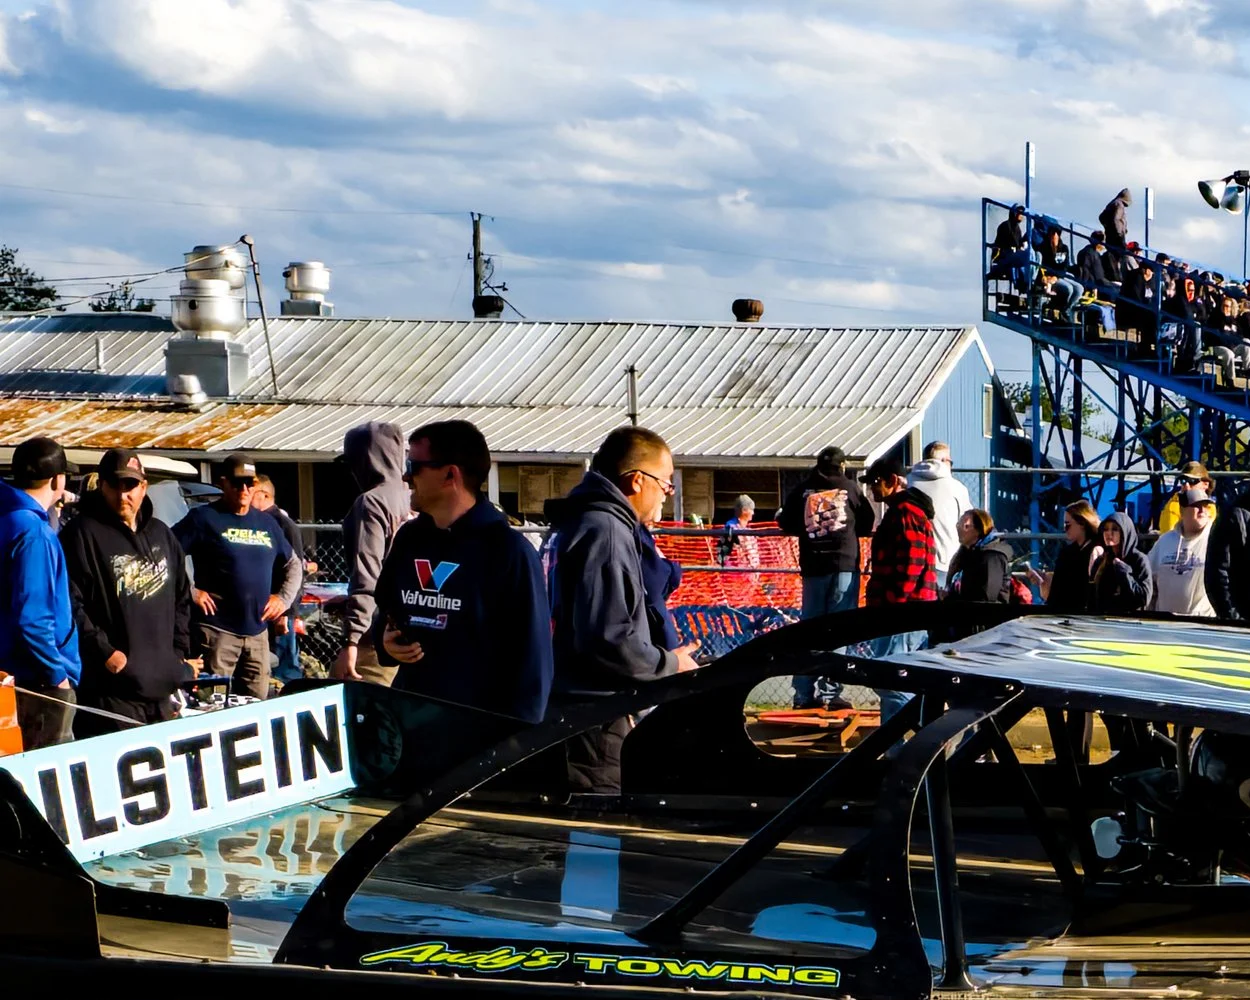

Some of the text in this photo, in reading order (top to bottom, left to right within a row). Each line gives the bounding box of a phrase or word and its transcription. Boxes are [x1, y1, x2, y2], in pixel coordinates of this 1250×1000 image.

[401, 589, 461, 611] Valvoline
[38, 704, 344, 844] ILSTEIN
[361, 943, 838, 985] Andy's TOWING
